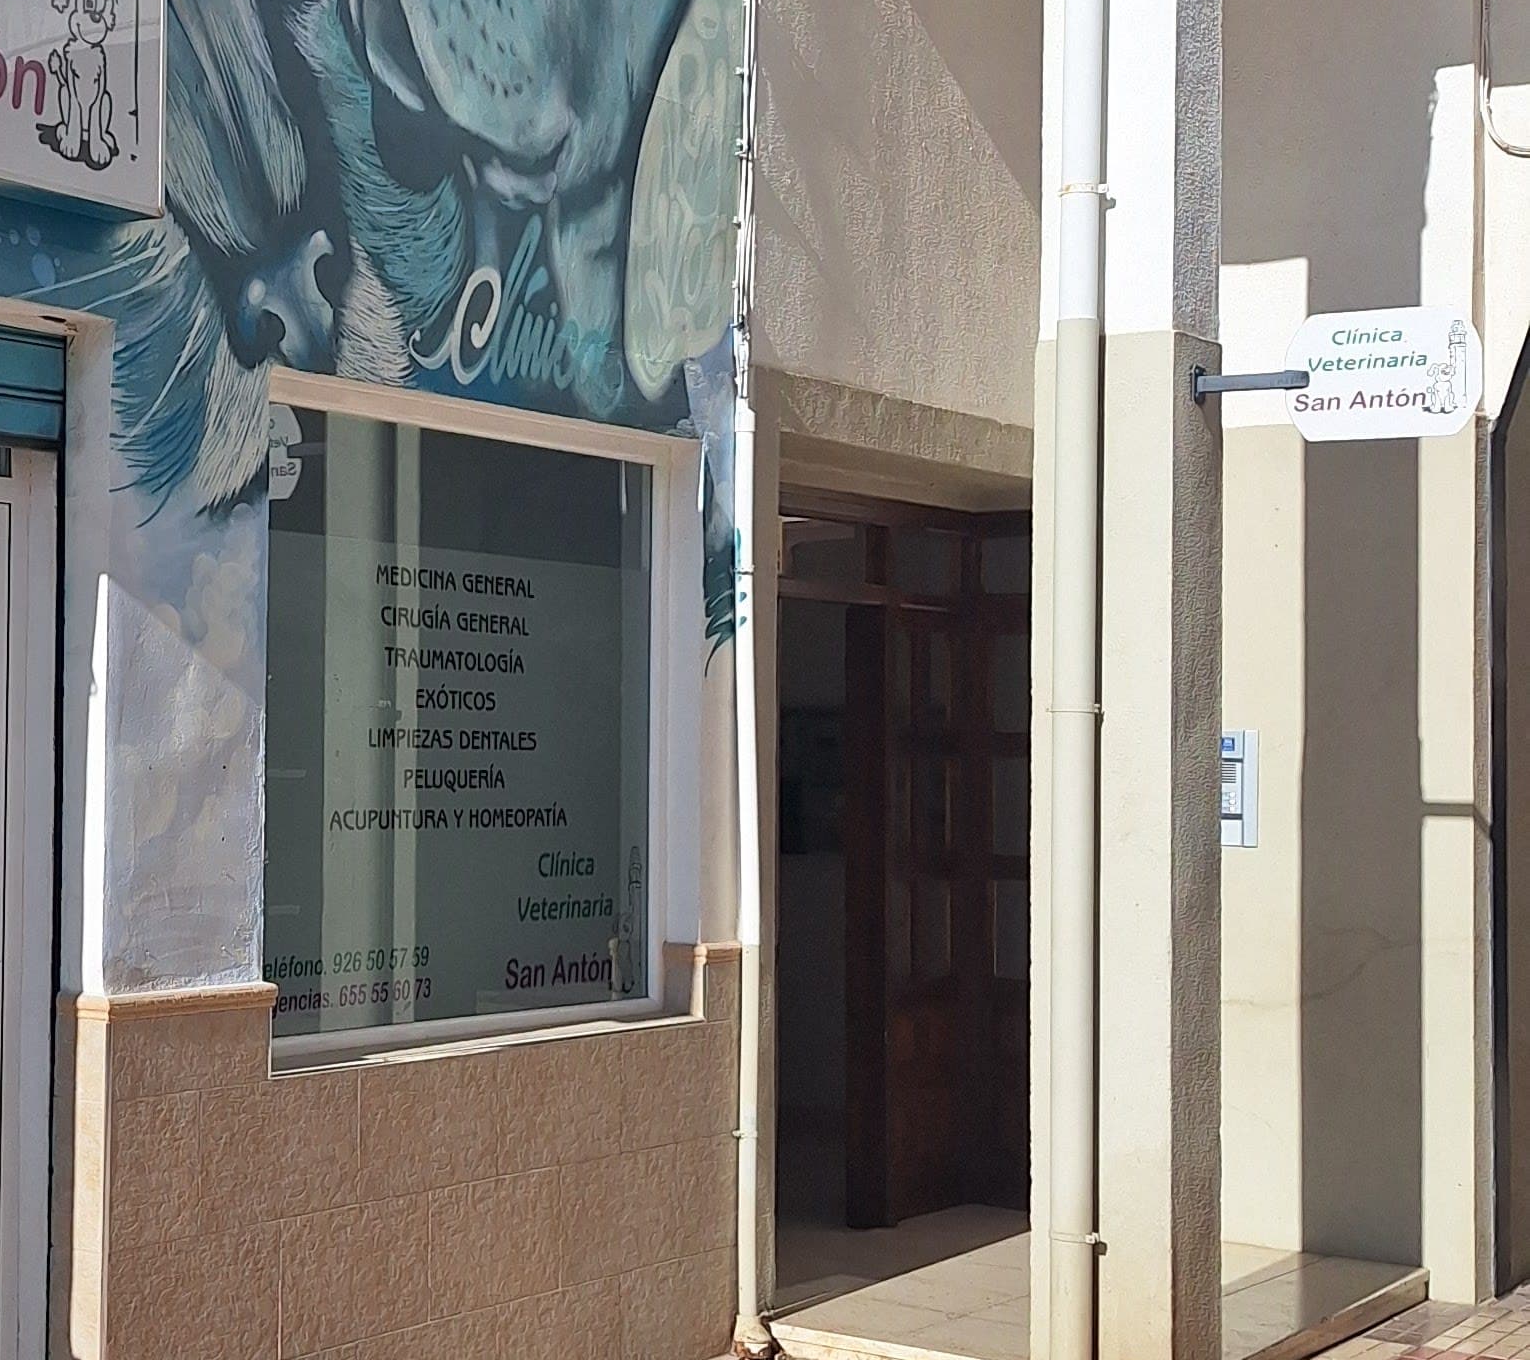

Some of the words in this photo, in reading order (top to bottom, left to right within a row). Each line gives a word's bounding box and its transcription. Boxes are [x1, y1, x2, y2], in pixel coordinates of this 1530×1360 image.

[1331, 327, 1403, 346] Clínica
[1308, 351, 1428, 373] Veterinaria
[1293, 393, 1340, 413] San
[1349, 387, 1426, 410] Antón
[375, 564, 457, 591] MEDICINA
[462, 573, 535, 599] GENERAL
[380, 603, 451, 631] CIRUGÍA
[456, 612, 530, 637] GENERAL
[384, 646, 525, 675] TRAUMATOLOGÍA
[415, 683, 497, 712] EXÓTICOS
[368, 728, 453, 750] LIMPIEZAS
[459, 730, 537, 751] DENTALES
[403, 763, 505, 792] PELUQUERÍA
[329, 808, 449, 831] ACUPUNTURA
[453, 808, 464, 829] Y
[469, 801, 568, 828] HOMEOPATÍA
[537, 850, 595, 878] Clínica
[517, 892, 614, 922] Veterinaria
[264, 954, 327, 980] eléfono.
[332, 951, 362, 975] 926
[365, 948, 385, 971] 50
[388, 947, 408, 970] 57
[411, 944, 430, 968] 59
[505, 957, 545, 990] San
[551, 952, 613, 987] Antón
[272, 988, 334, 1019] encias.
[338, 983, 367, 1007] 655
[371, 981, 389, 1003] 55
[393, 979, 411, 1002] 60
[414, 977, 432, 999] 73
